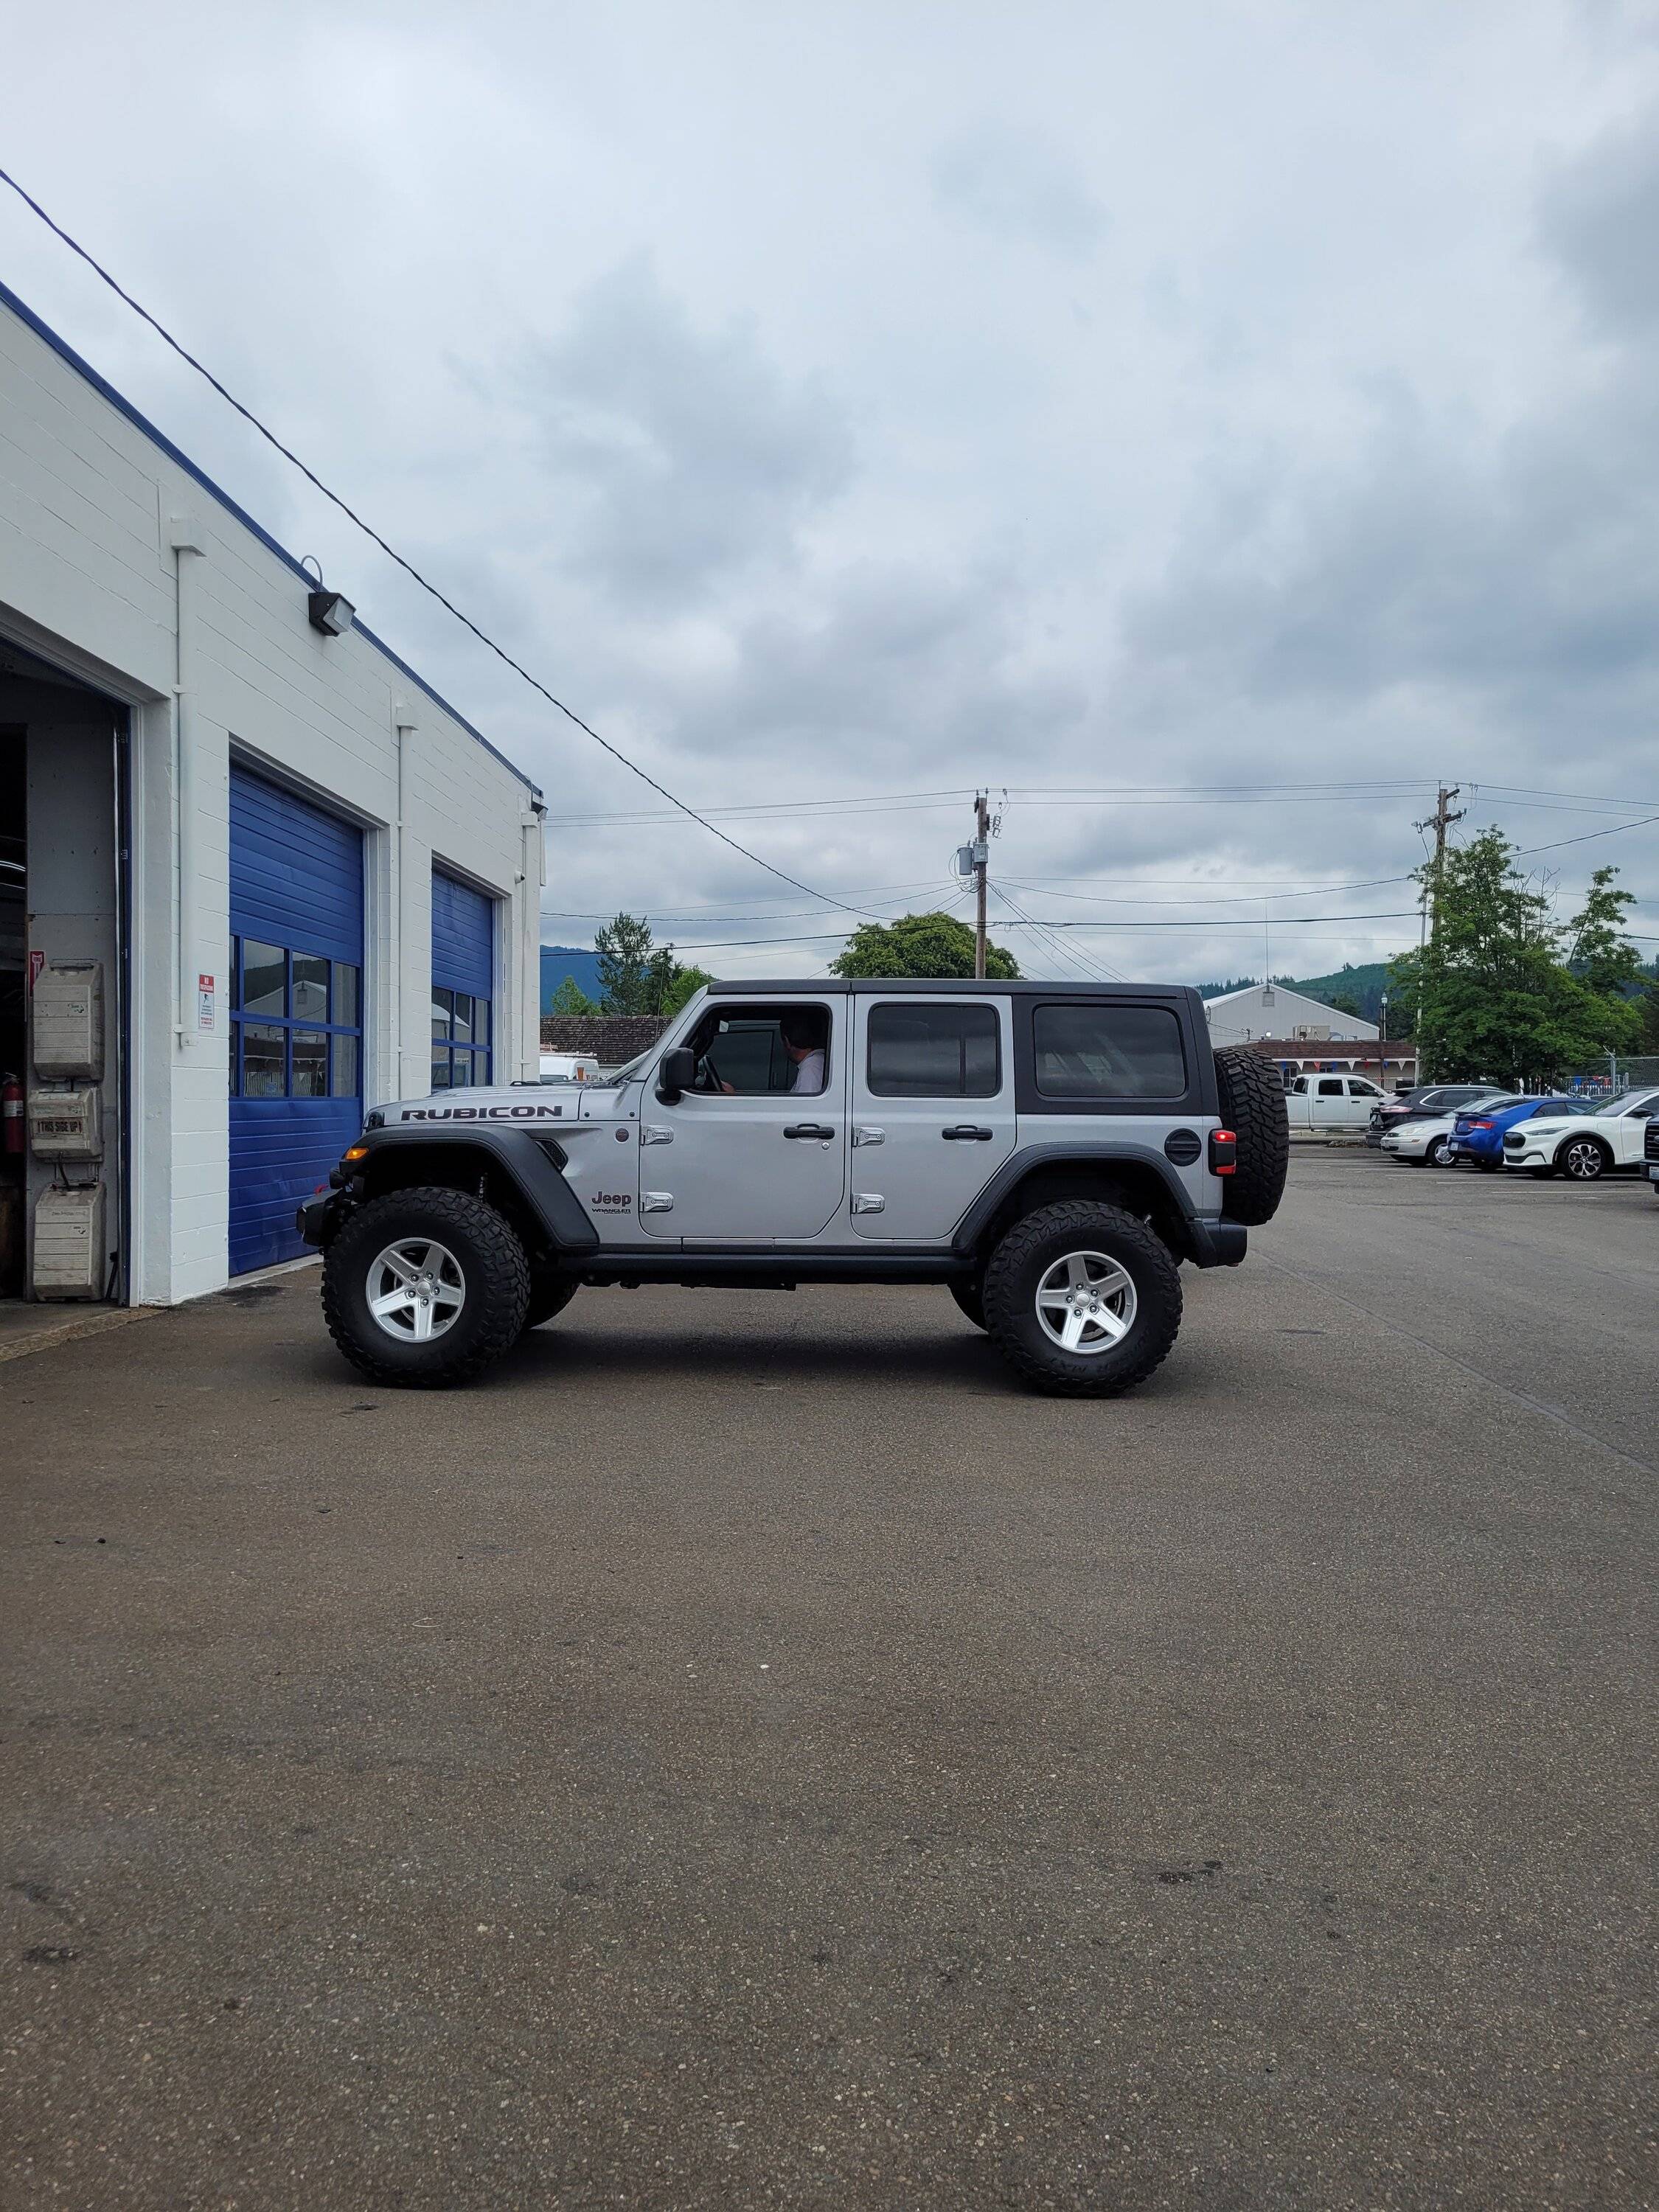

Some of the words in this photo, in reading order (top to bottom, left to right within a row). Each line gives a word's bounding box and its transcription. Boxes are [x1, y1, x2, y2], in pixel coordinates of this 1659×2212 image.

[401, 1106, 563, 1121] RUBICON
[41, 1121, 54, 1133] THIS
[55, 1121, 69, 1133] SIDE
[70, 1121, 78, 1133] UP
[591, 1191, 632, 1207] Jeep
